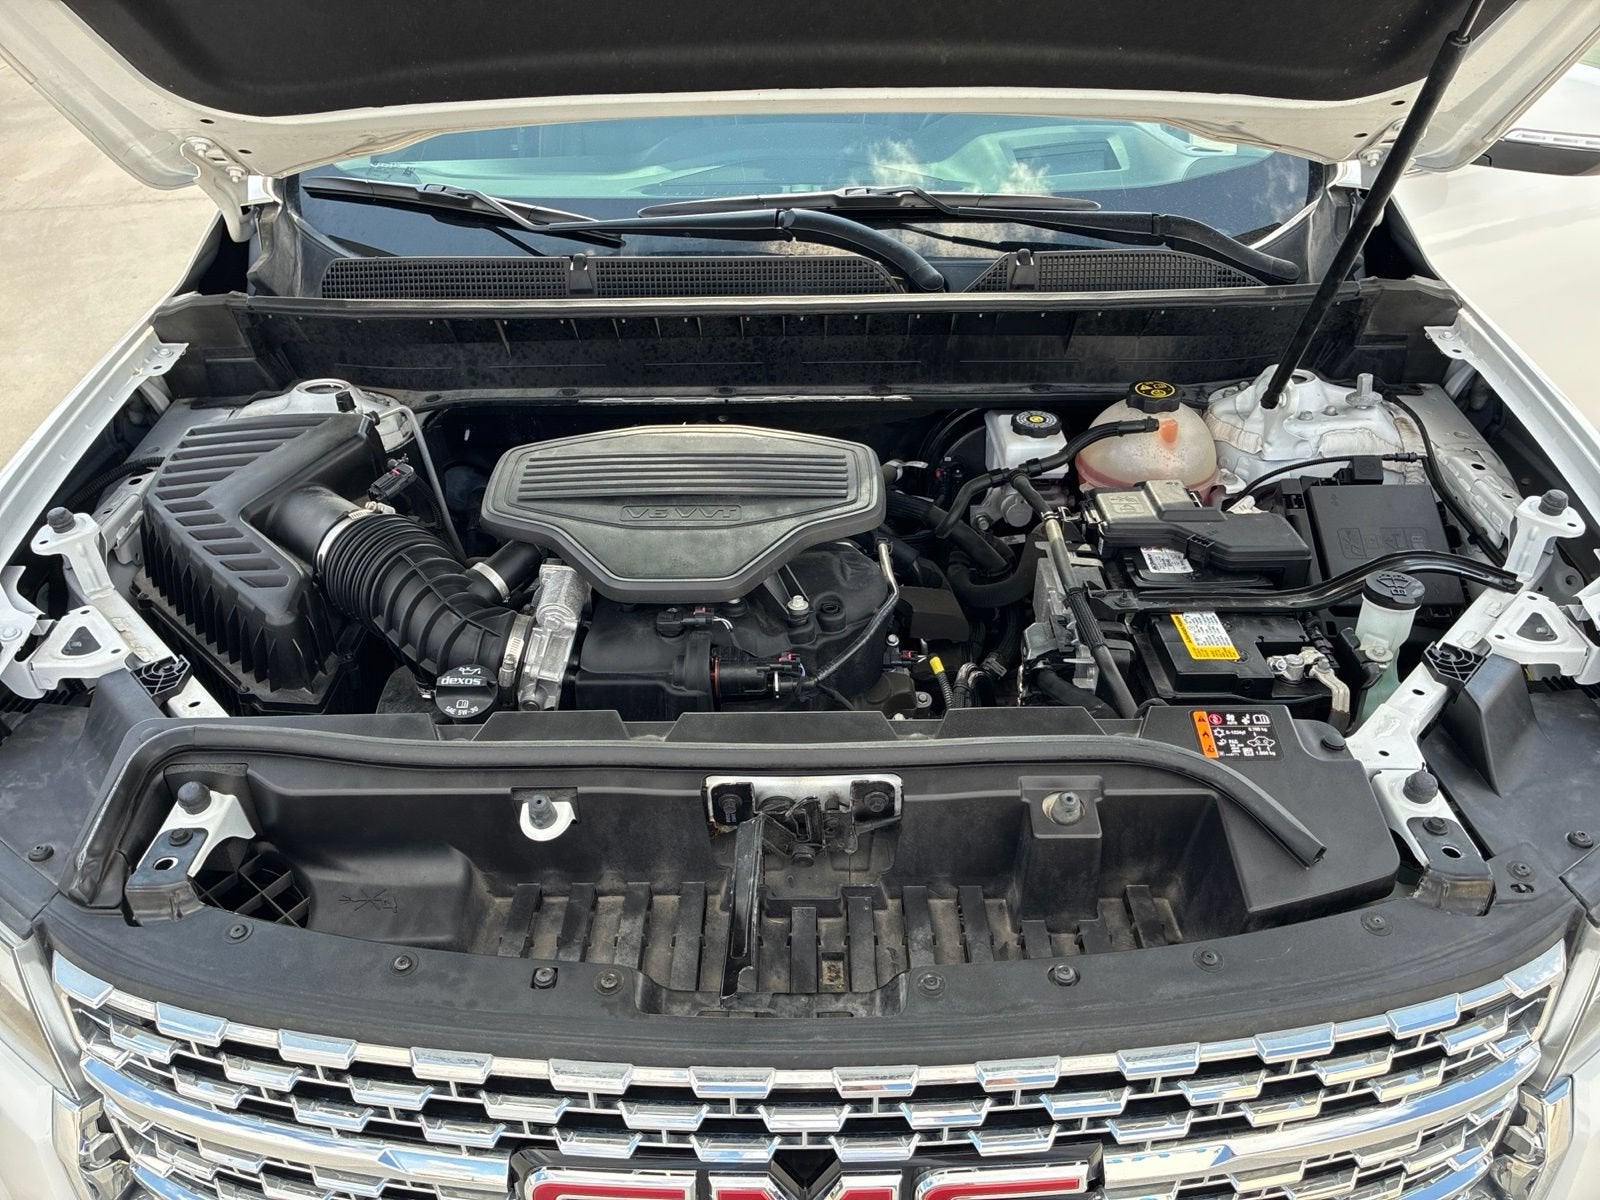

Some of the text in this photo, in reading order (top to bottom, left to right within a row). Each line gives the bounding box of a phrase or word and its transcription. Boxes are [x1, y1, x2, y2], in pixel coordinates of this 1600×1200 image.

[675, 507, 737, 518] VVT
[440, 676, 483, 686] dexos
[445, 705, 457, 715] SAE
